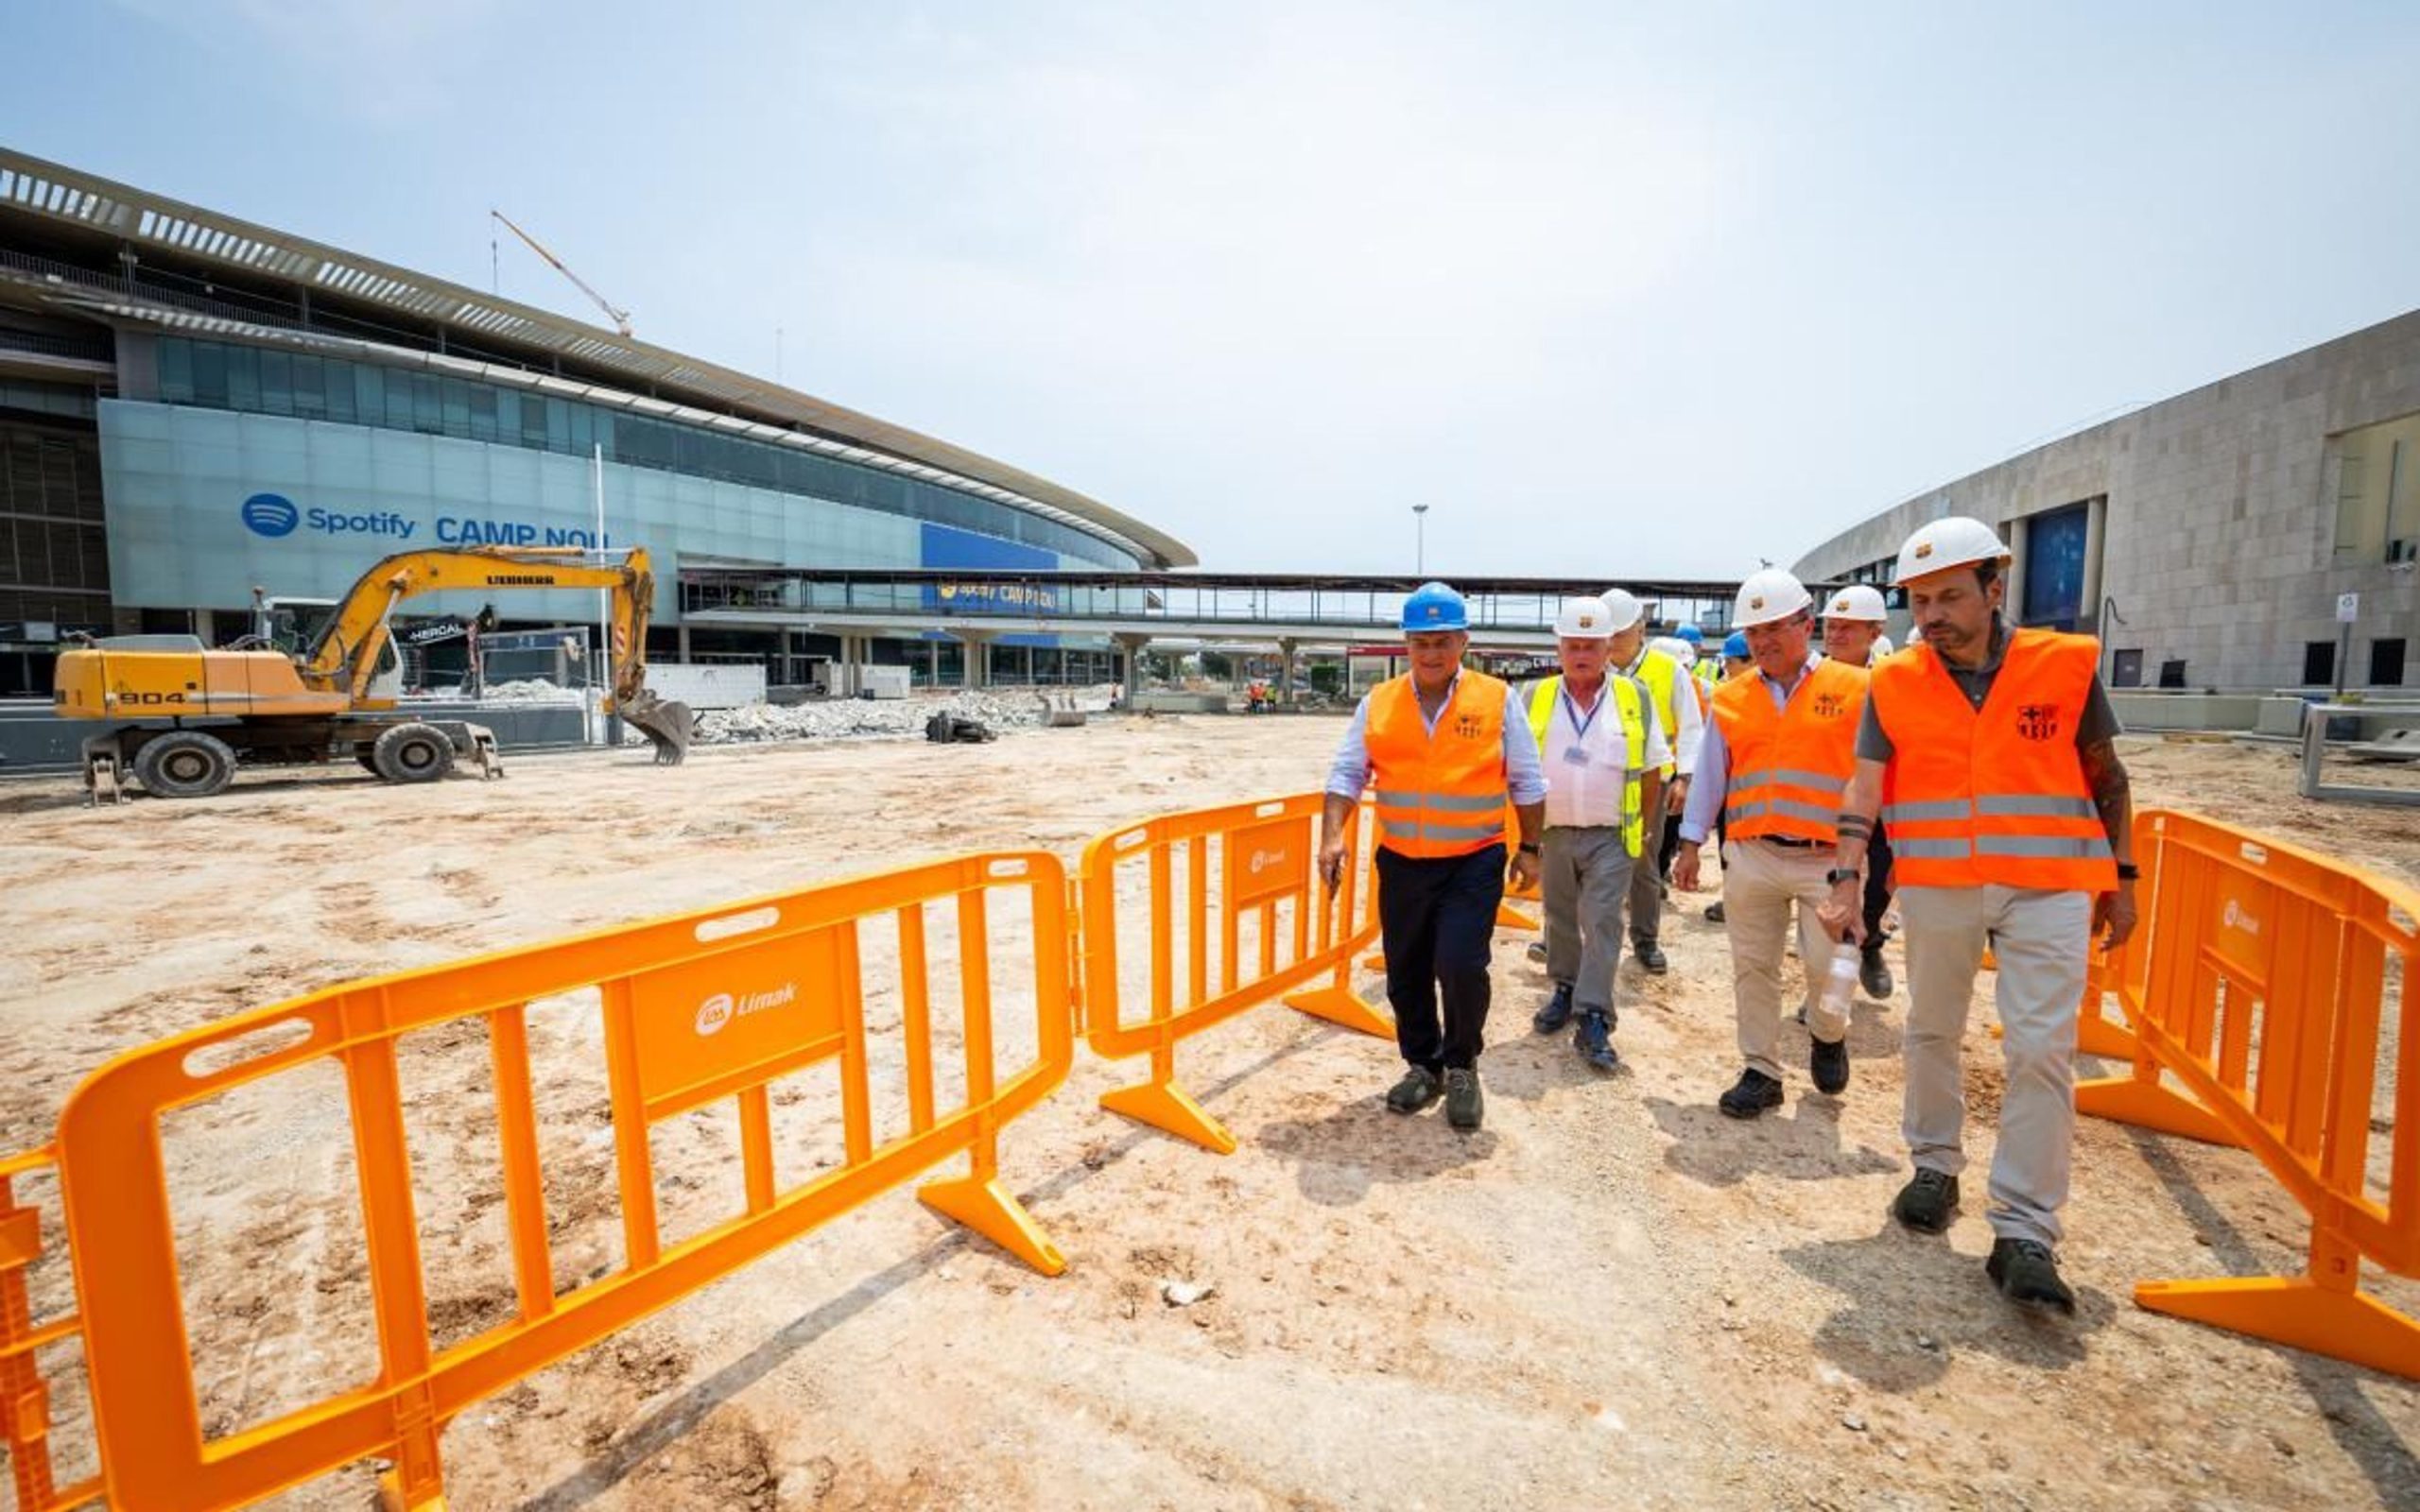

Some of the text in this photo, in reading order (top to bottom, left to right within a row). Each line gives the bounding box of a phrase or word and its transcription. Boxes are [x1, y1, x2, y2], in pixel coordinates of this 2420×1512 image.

[307, 508, 415, 539] Spotify
[437, 518, 536, 545] CAMP
[120, 693, 186, 704] 904
[737, 982, 798, 1017] Limak
